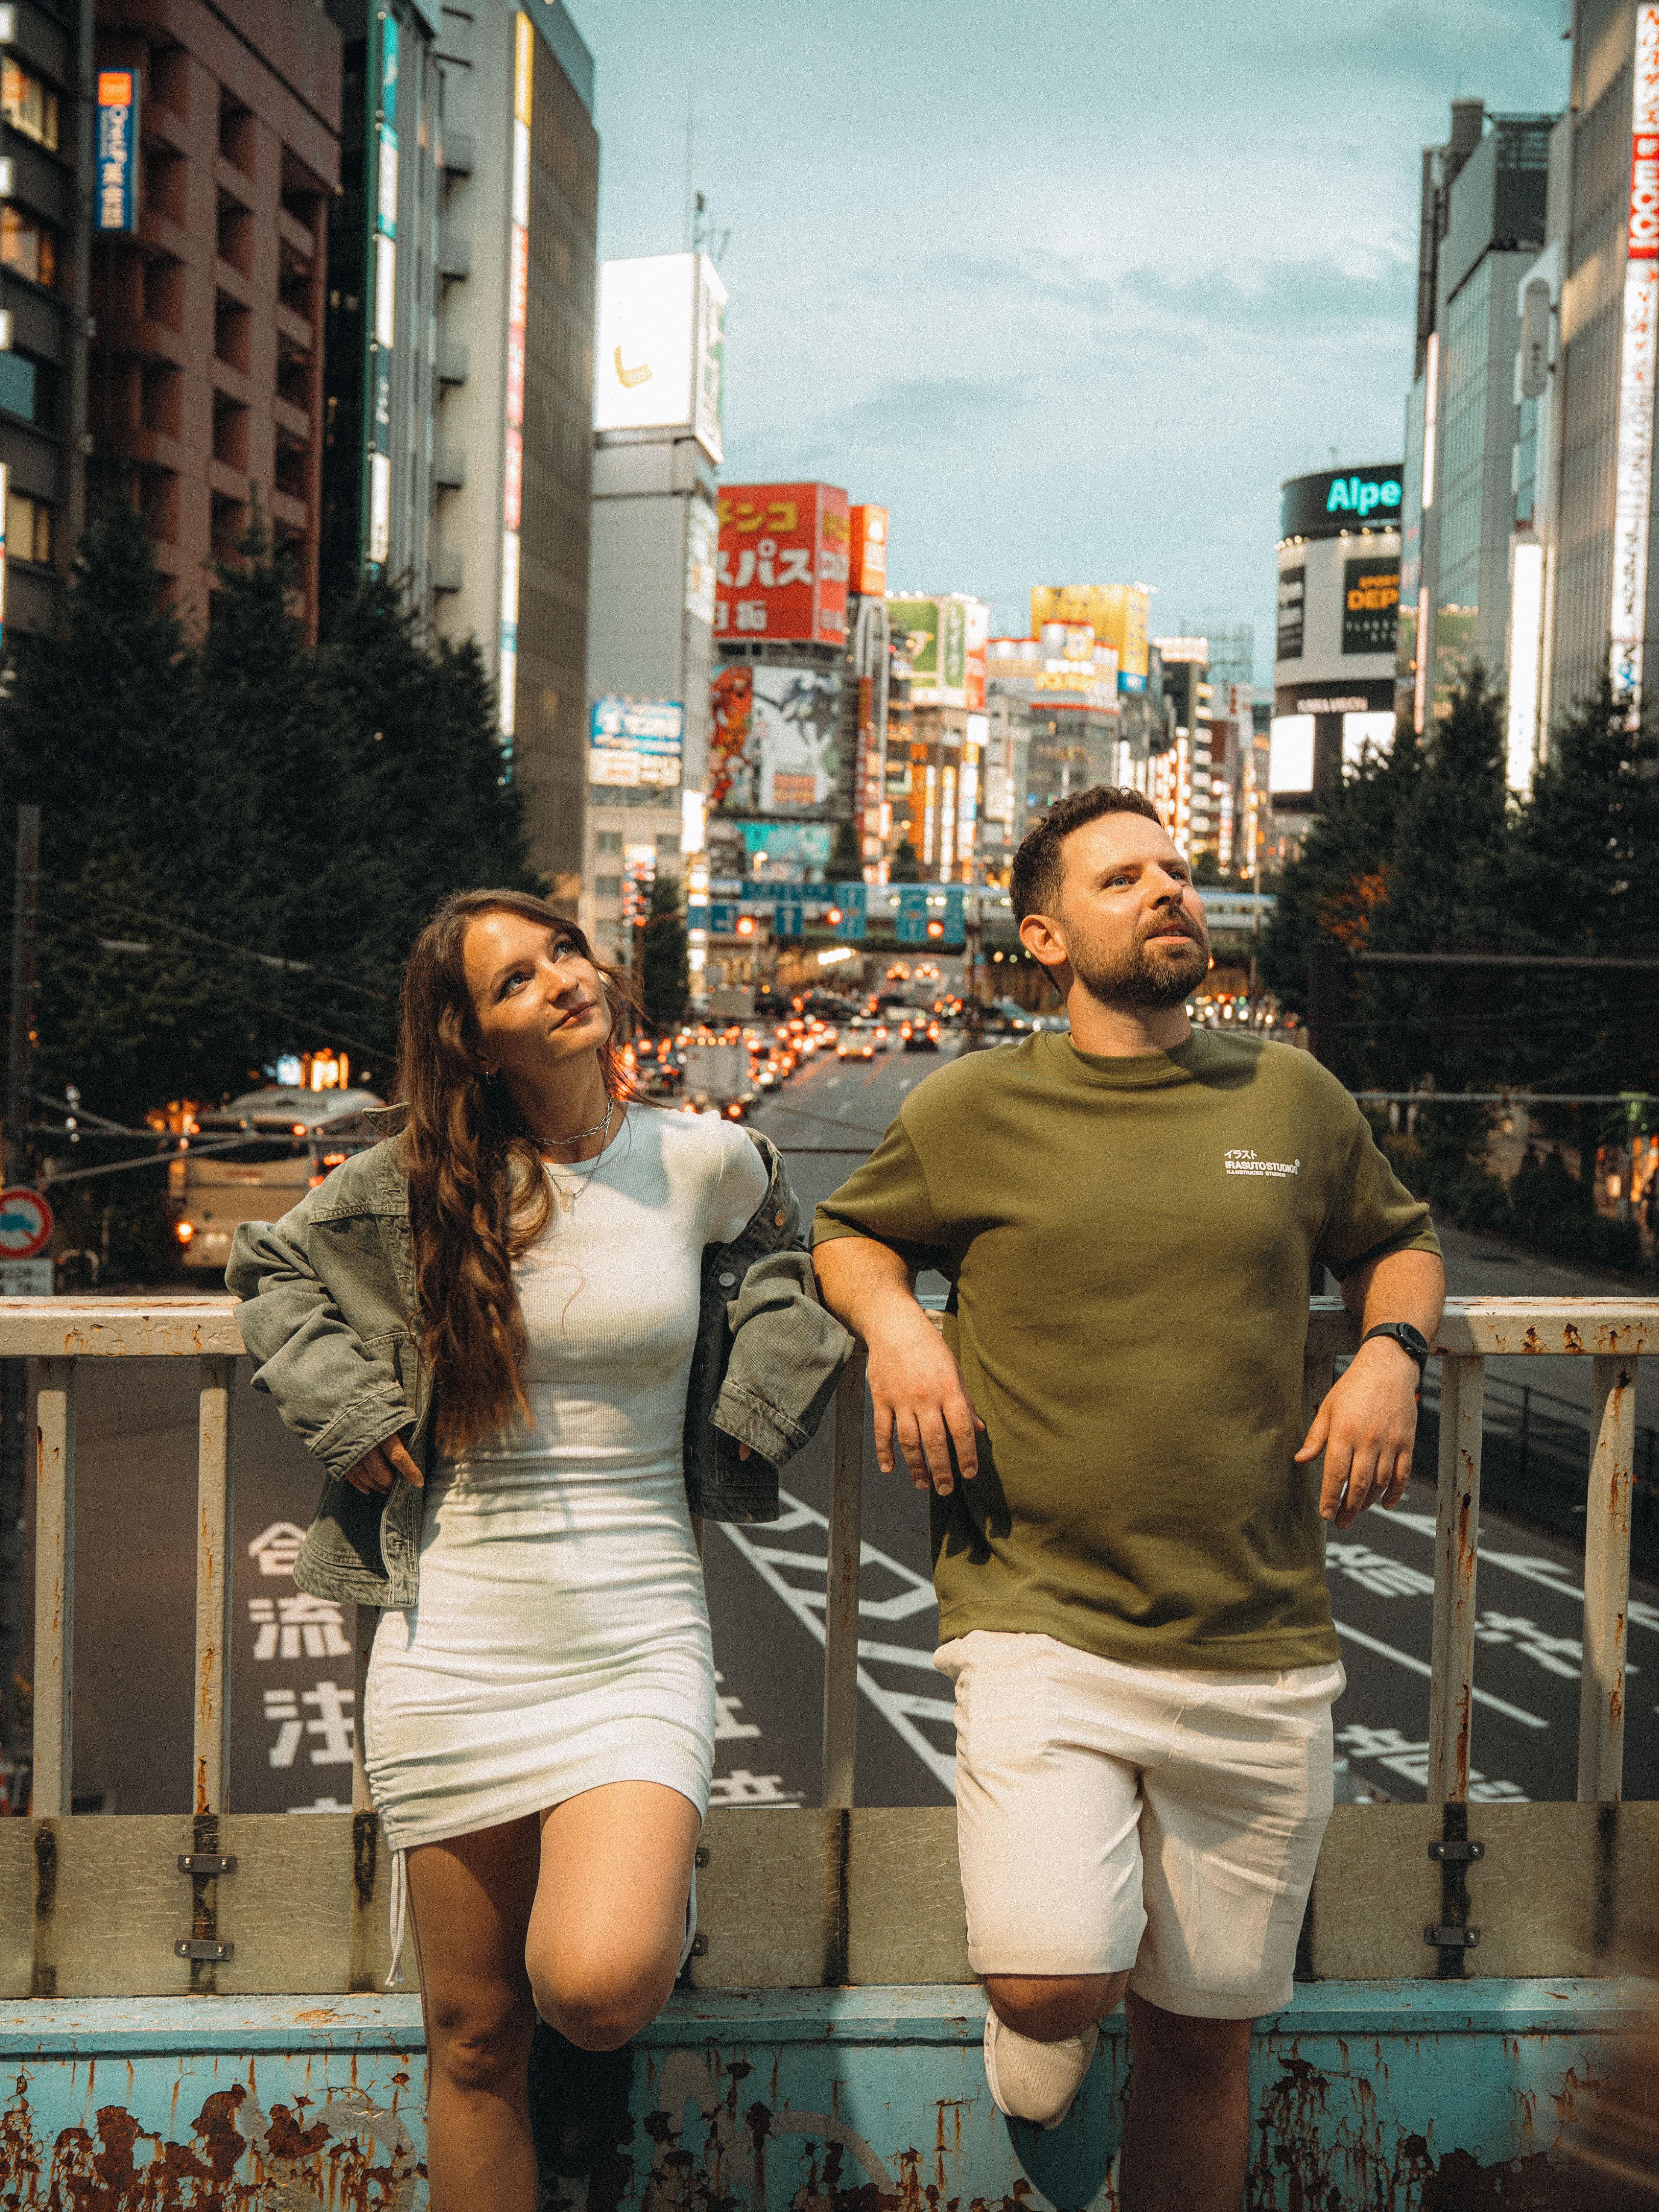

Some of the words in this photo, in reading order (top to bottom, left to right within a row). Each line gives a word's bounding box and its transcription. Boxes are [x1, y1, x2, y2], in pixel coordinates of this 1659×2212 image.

[1224, 1149, 1257, 1160] イラスト
[1225, 1161, 1266, 1171] IRASUTO
[1266, 1162, 1298, 1175] STUDIOS
[248, 1522, 355, 1814] 合流注
